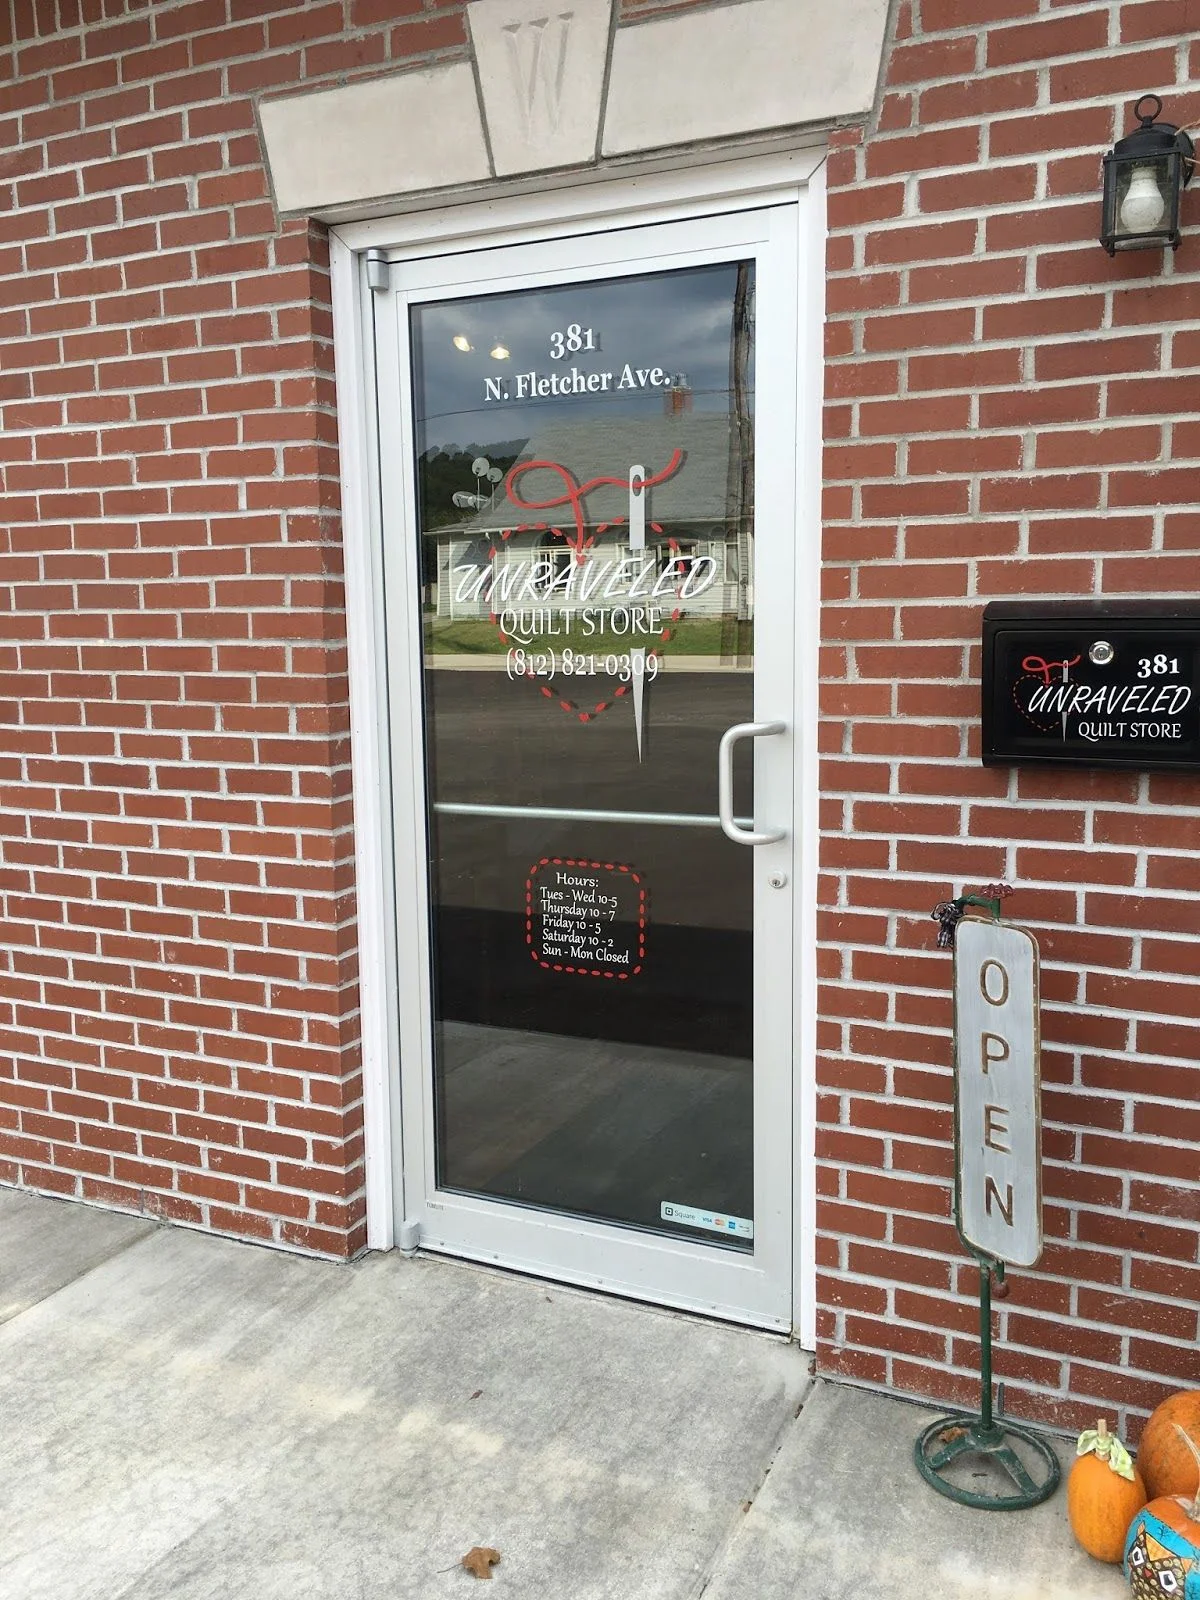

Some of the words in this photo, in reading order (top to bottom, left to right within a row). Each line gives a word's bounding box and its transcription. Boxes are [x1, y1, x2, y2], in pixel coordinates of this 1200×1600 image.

[501, 11, 574, 143] W
[550, 323, 596, 360] 381
[484, 377, 509, 401] N.
[515, 368, 613, 398] Fletcher
[617, 364, 671, 390] Ave.
[453, 556, 717, 603] UNRAVELED
[499, 608, 576, 644] QUILT
[582, 607, 664, 636] STORE
[506, 647, 555, 681] (812)
[562, 648, 658, 682] 821-0309
[1137, 654, 1180, 678] 381
[1028, 685, 1192, 715] UNRAVELED
[1078, 721, 1127, 742] QUILT
[1129, 722, 1181, 738] STORE
[556, 872, 599, 887] Hours:
[540, 886, 563, 900] Tues
[572, 889, 595, 903] Wed
[540, 900, 587, 920] Thursday
[589, 908, 600, 918] 10
[609, 910, 615, 922] 7
[542, 914, 574, 932] Friday
[576, 920, 586, 930] 10
[595, 923, 601, 934] 5
[542, 928, 586, 948] Saturday
[588, 936, 598, 946] 10
[607, 938, 614, 947] 2
[542, 943, 562, 956] Sun
[570, 946, 593, 960] Mon
[595, 948, 629, 964] Closed
[980, 958, 1014, 1228] OPEN
[674, 1210, 696, 1220] Square
